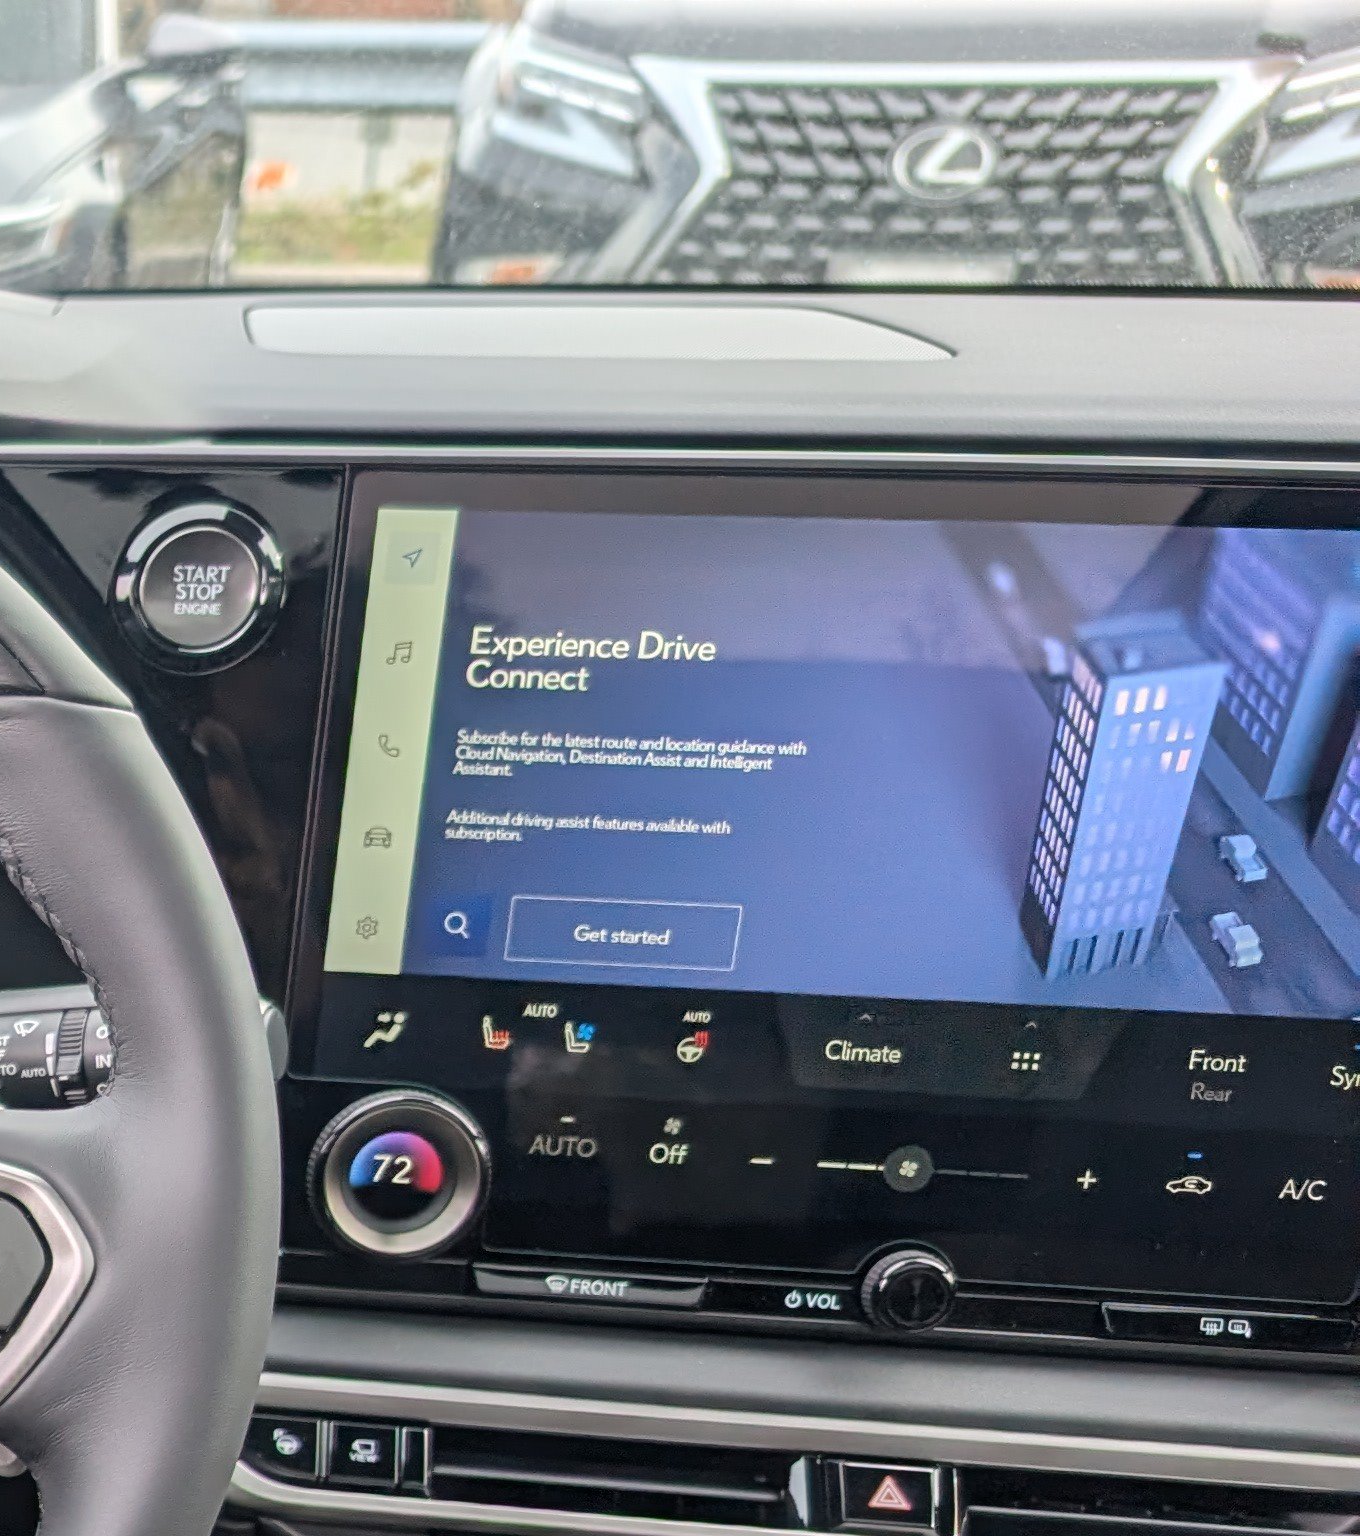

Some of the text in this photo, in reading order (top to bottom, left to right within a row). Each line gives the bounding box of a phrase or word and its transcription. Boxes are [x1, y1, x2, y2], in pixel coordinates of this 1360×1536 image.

[173, 564, 231, 582] START
[175, 583, 224, 600] STOP
[173, 602, 222, 615] ENGINE
[470, 624, 716, 662] Experience Drive
[466, 658, 590, 692] Connect
[457, 728, 808, 756] Subscribe for the latest route and location guidance with
[452, 761, 513, 777] Assistant.
[455, 744, 773, 772] Cloud Navigation, Destination Assist and Intelligent
[445, 809, 731, 835] Additional driving assist features available with
[573, 924, 672, 946] Get started
[522, 1003, 558, 1019] AUTO
[682, 1011, 712, 1024] AUTO
[825, 1040, 902, 1064] Climate
[1188, 1048, 1247, 1073] Front
[20, 1067, 47, 1079] AUTO
[1190, 1082, 1232, 1102] Rear
[529, 1134, 598, 1158] AUTO
[649, 1142, 689, 1165] Off
[372, 1153, 413, 1185] 72
[1278, 1178, 1327, 1201] A/C
[569, 1278, 629, 1297] FRONT
[806, 1292, 841, 1311] VOL
